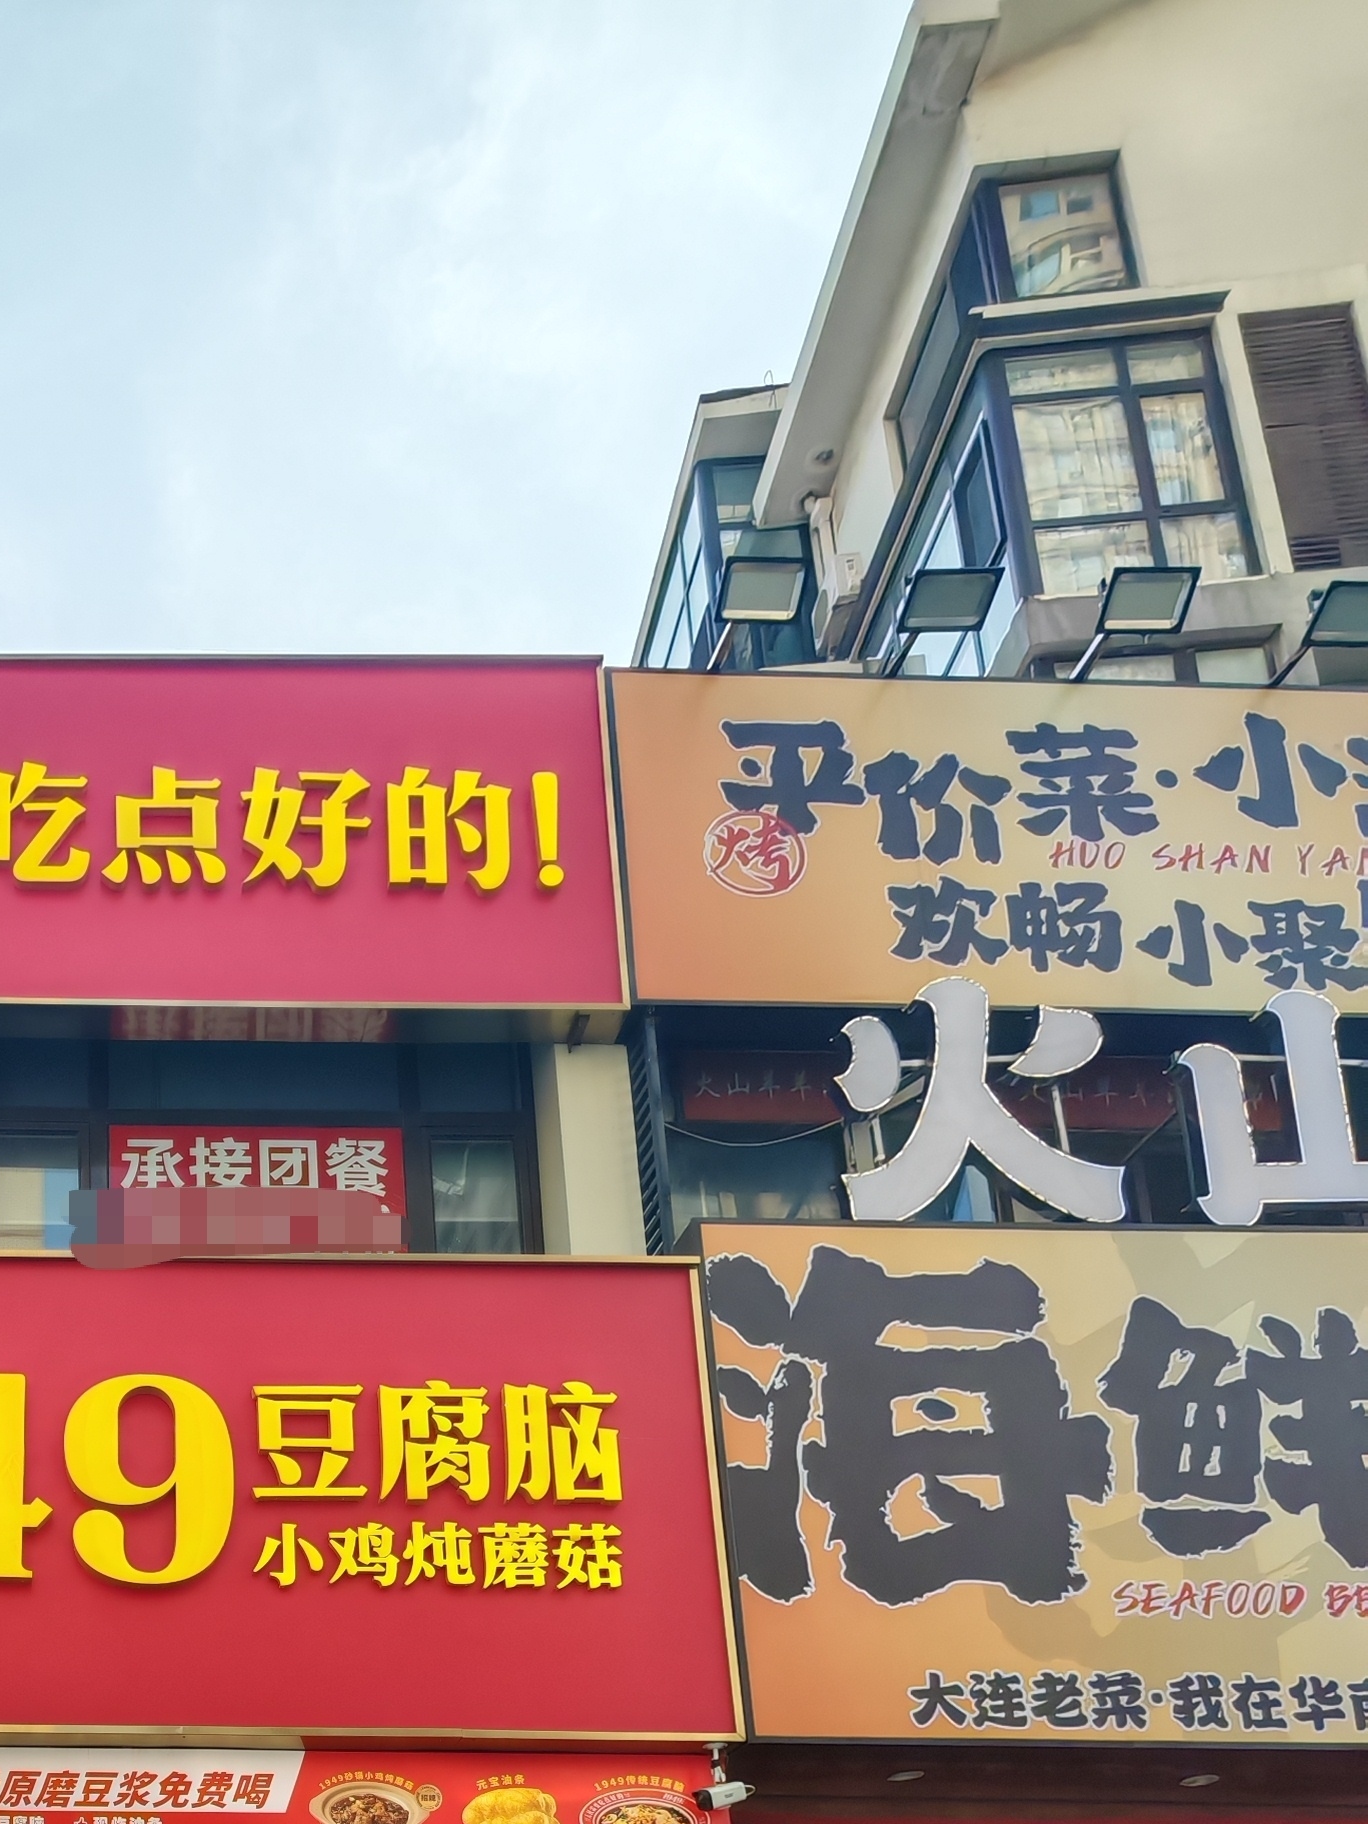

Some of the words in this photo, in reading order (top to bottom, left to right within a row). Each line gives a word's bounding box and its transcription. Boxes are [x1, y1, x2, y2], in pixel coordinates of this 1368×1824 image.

[720, 712, 1368, 864] 平价菜·小
[1049, 840, 1127, 872] HUO
[1152, 842, 1272, 876] SHAN
[835, 976, 1368, 1226] 火山
[119, 1136, 389, 1198] 承接团餐
[249, 1380, 625, 1509] 豆腐脑
[706, 1244, 1368, 1608] 海鲜
[251, 1520, 626, 1594] 小鸡炖蘑菇
[1113, 1581, 1306, 1619] SEAFOOD
[475, 1774, 526, 1792] 元宝油条
